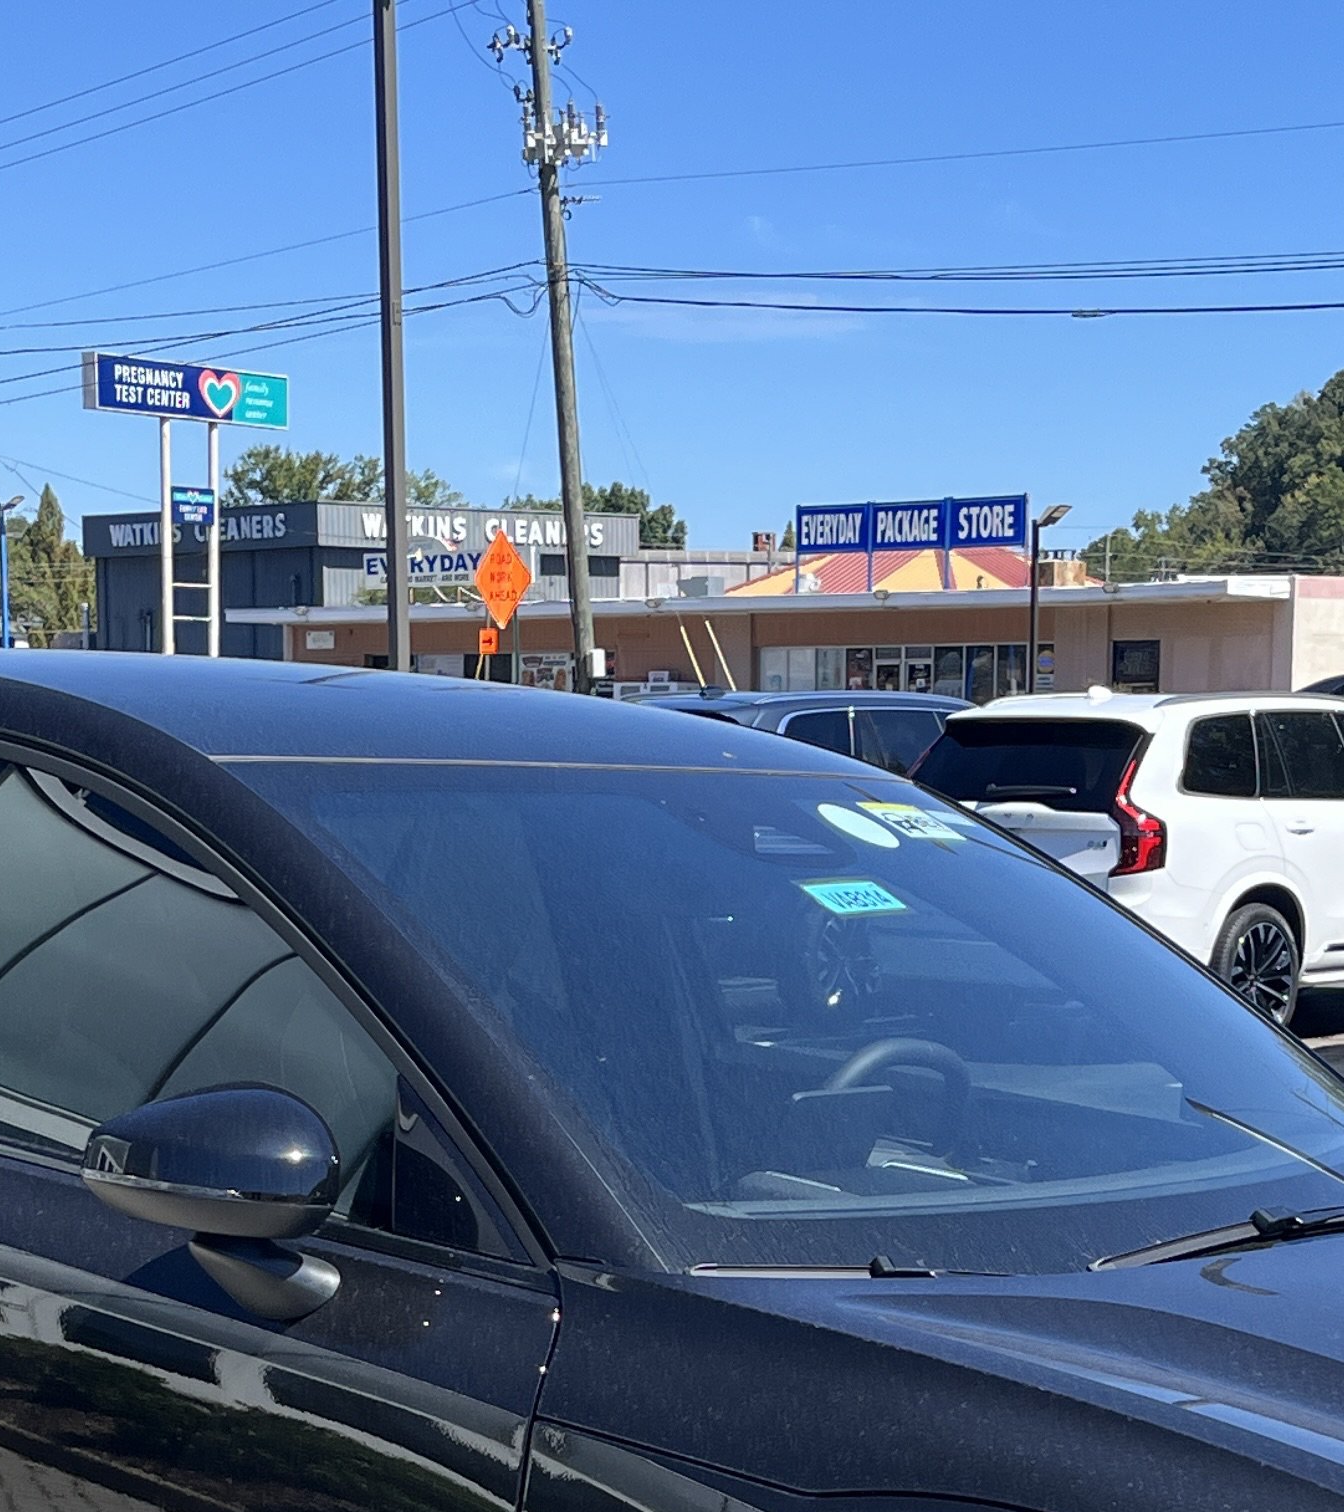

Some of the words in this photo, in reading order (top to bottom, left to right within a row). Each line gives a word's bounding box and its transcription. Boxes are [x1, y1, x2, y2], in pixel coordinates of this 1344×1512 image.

[114, 364, 184, 389] PREGNANCY
[115, 384, 143, 404] TEST
[146, 387, 190, 409] CENTER
[109, 523, 182, 547] WATKIS
[801, 512, 863, 545] EVERYDAY
[876, 508, 939, 543] PACKAGE
[958, 504, 1015, 540] STORE
[366, 552, 482, 576] EVRYDAY
